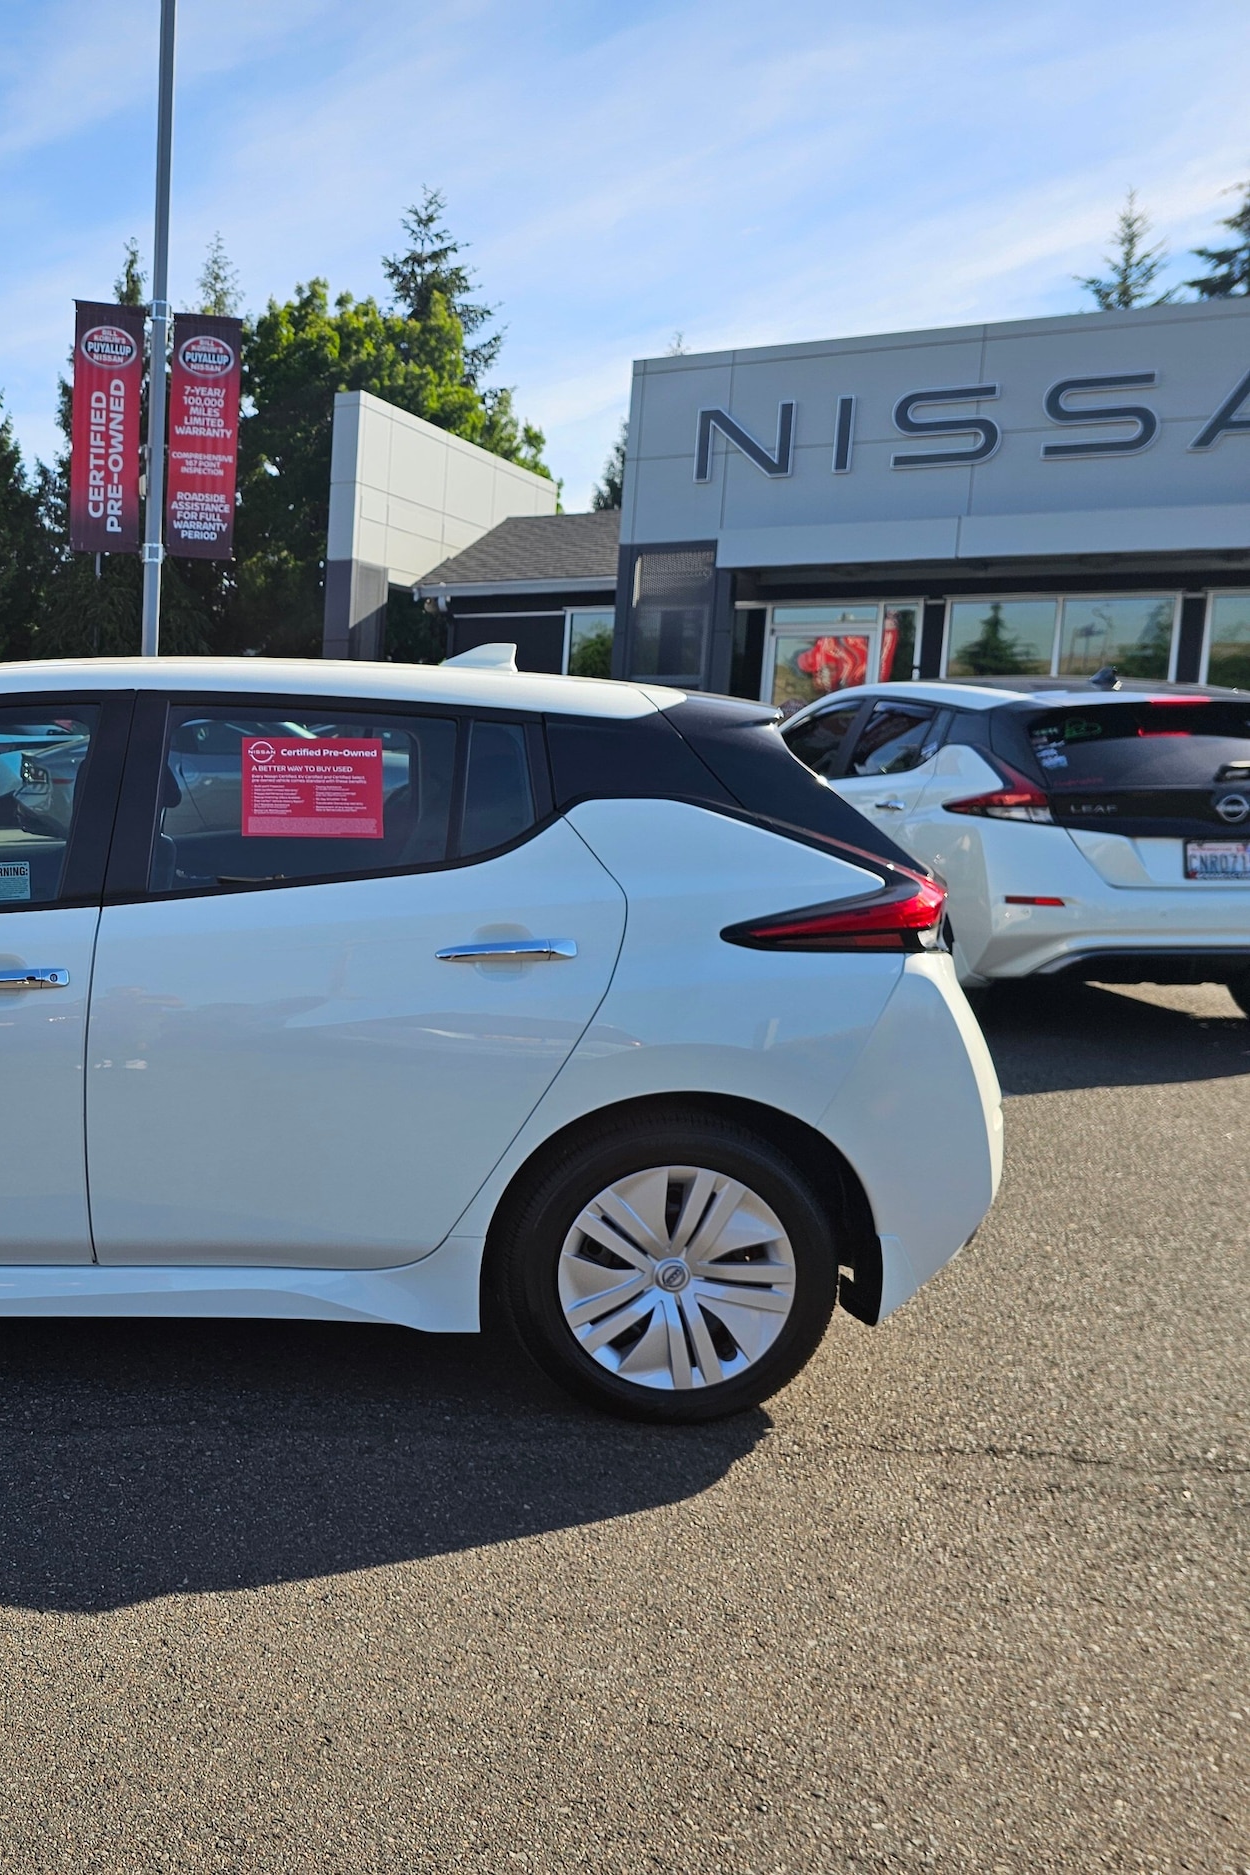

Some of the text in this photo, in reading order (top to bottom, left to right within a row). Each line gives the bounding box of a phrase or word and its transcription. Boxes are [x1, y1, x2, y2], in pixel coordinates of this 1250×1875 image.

[87, 341, 132, 357] PUYALLUP
[93, 353, 124, 364] NISSAN
[185, 351, 230, 366] PUYALLUP
[190, 363, 222, 372] NISSAN
[184, 386, 226, 399] 7-YEAR/
[182, 395, 225, 409] 100,000
[190, 406, 221, 418] MILES
[184, 416, 225, 428] LIMITED
[175, 425, 233, 439] WARRANTY
[88, 391, 107, 518] CERTIFIED
[106, 378, 125, 533] PRE-OWNED
[171, 451, 234, 464] COMPREHENSIVE
[198, 460, 221, 469] POINT
[181, 466, 224, 476] INSPECTION
[176, 491, 226, 503] ROADSIDE
[171, 501, 230, 513] ASSISTANCE
[177, 510, 222, 522] FOR FULL
[173, 520, 228, 532] WARRANTY
[181, 530, 218, 541] PERIOD
[280, 748, 377, 758] Certified Pre-Owned
[1070, 804, 1118, 814] LEAF
[1189, 853, 1250, 872] CNR071
